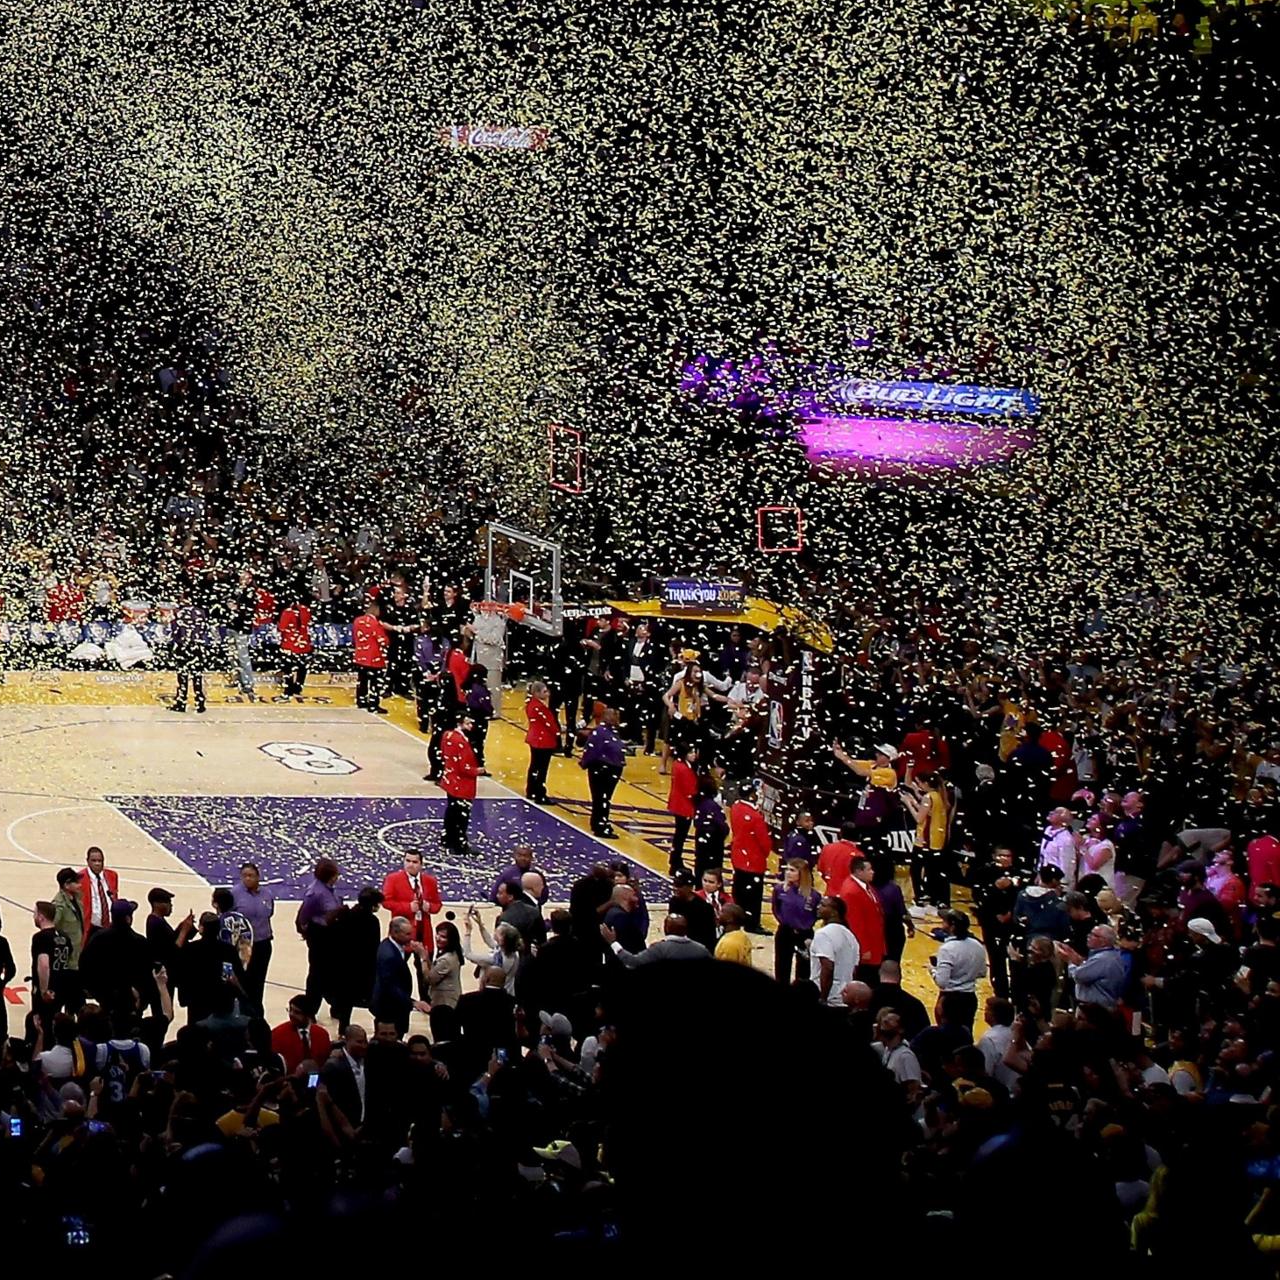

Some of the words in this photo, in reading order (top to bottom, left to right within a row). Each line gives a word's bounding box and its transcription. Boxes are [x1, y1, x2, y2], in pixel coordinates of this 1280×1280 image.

[856, 383, 923, 403] BUD
[925, 387, 1023, 410] LIGHT
[667, 587, 699, 602] THANK
[700, 588, 716, 602] YOU
[561, 606, 612, 618] KERS.COM
